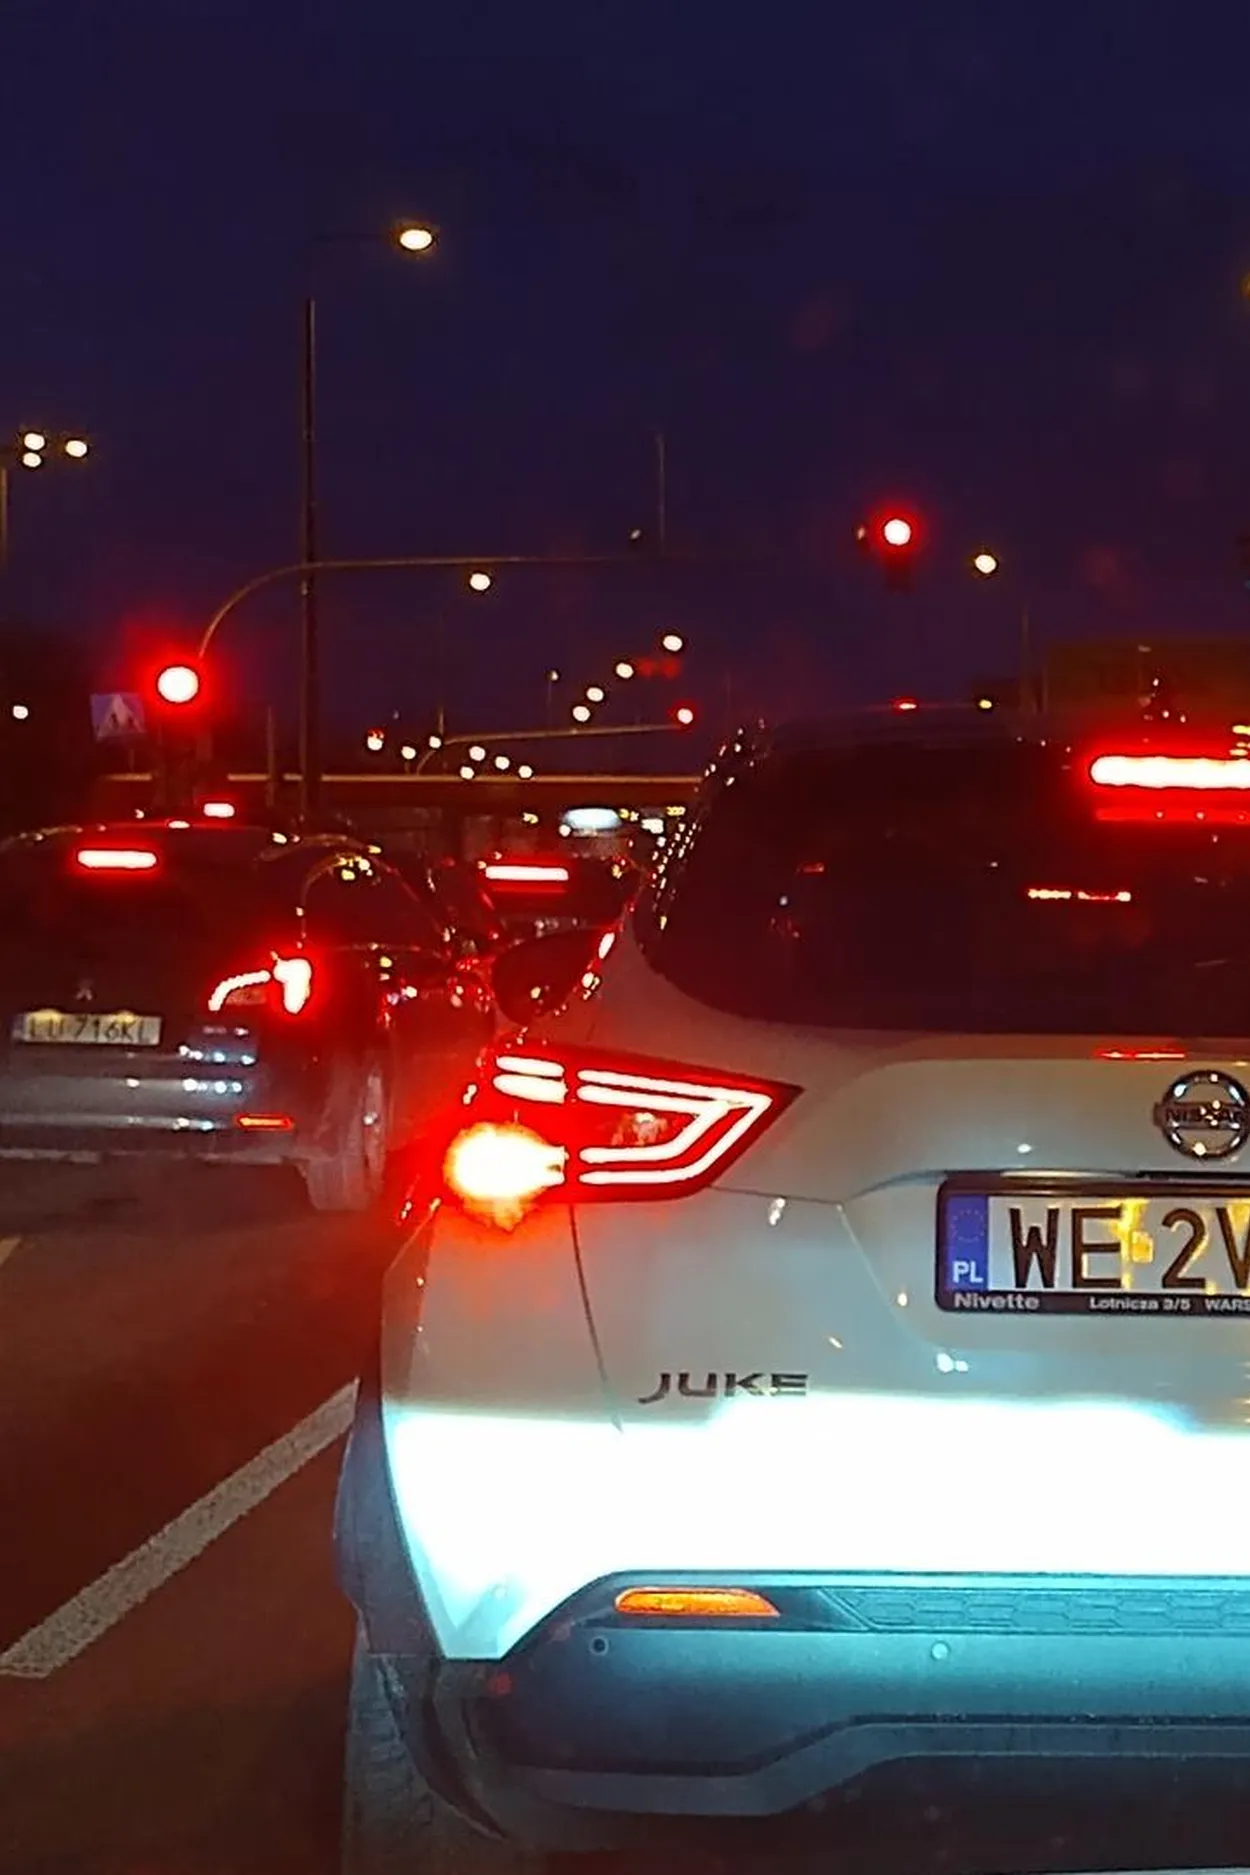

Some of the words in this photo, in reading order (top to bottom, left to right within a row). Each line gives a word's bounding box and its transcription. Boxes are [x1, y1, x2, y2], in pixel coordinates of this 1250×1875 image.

[1009, 1208, 1121, 1288] WE
[954, 1261, 983, 1283] PL
[954, 1293, 1040, 1310] Nivette
[1090, 1297, 1159, 1310] Lotnicza
[1163, 1298, 1191, 1311] 3/5
[638, 1373, 808, 1404] JUKE
